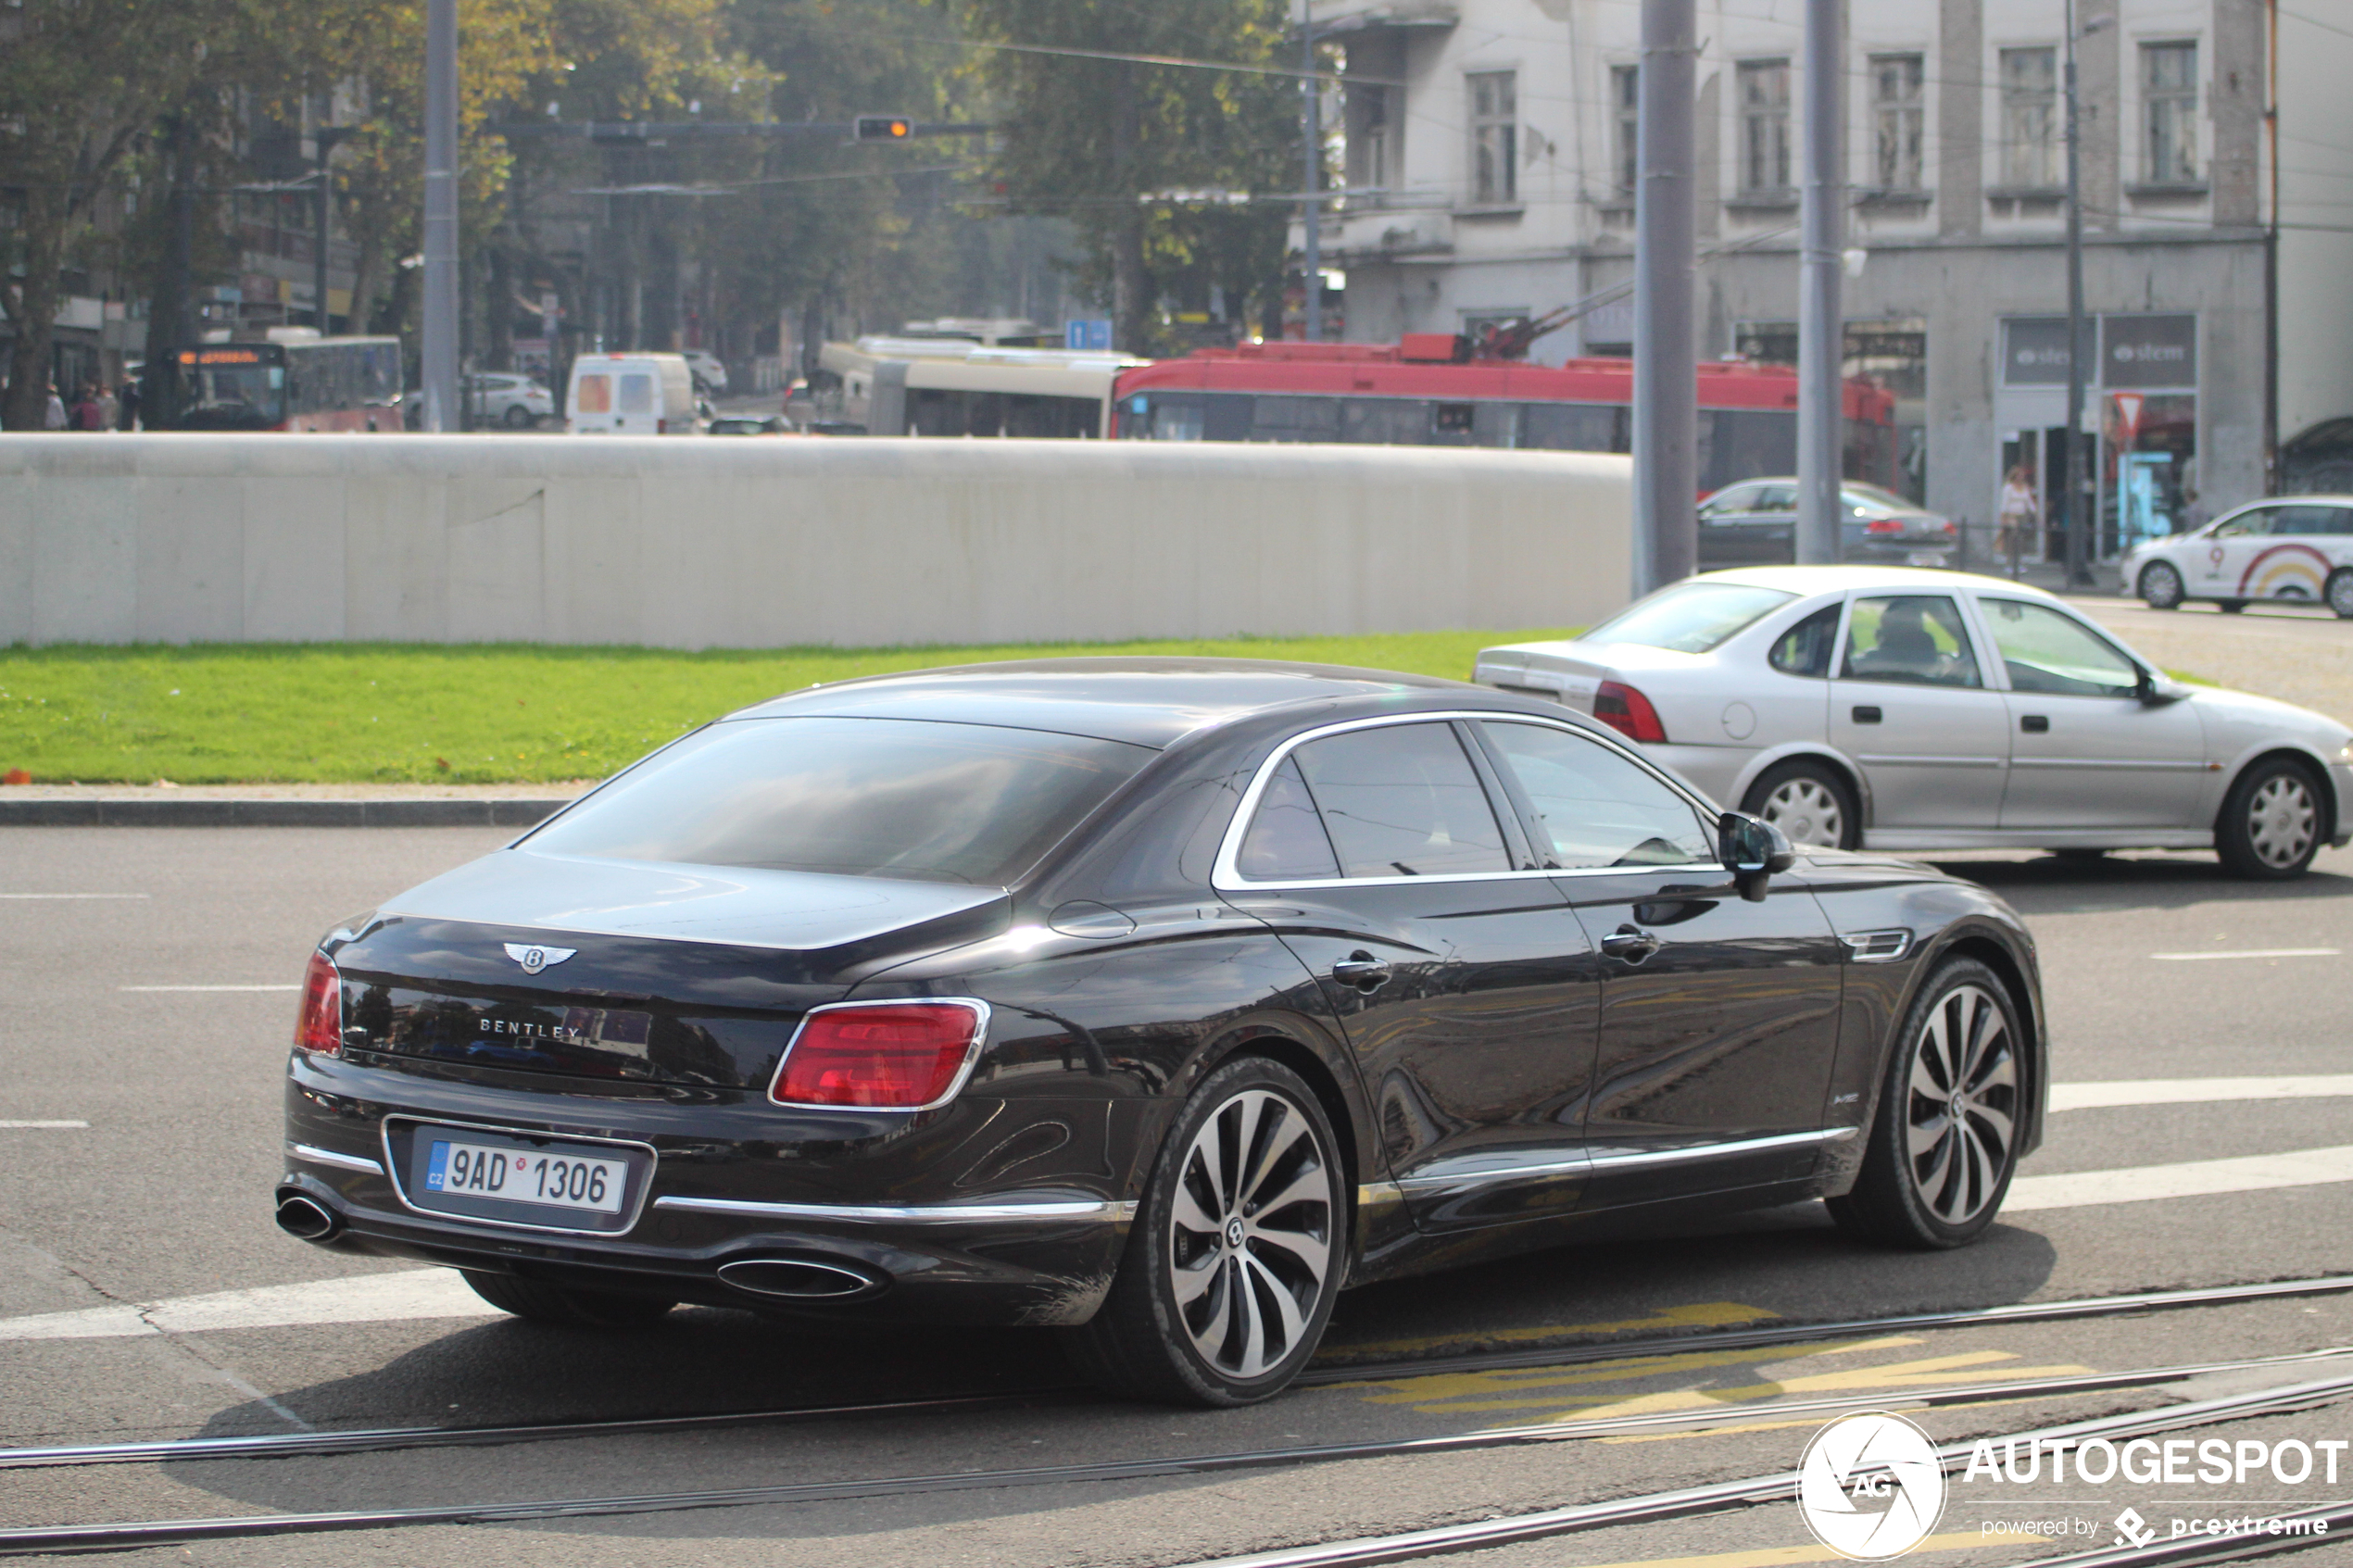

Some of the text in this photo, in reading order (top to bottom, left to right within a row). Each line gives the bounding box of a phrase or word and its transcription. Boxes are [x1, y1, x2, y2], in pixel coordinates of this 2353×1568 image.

[480, 1019, 579, 1038] BENTLEY
[428, 1149, 608, 1203] CZ 9AD 1306
